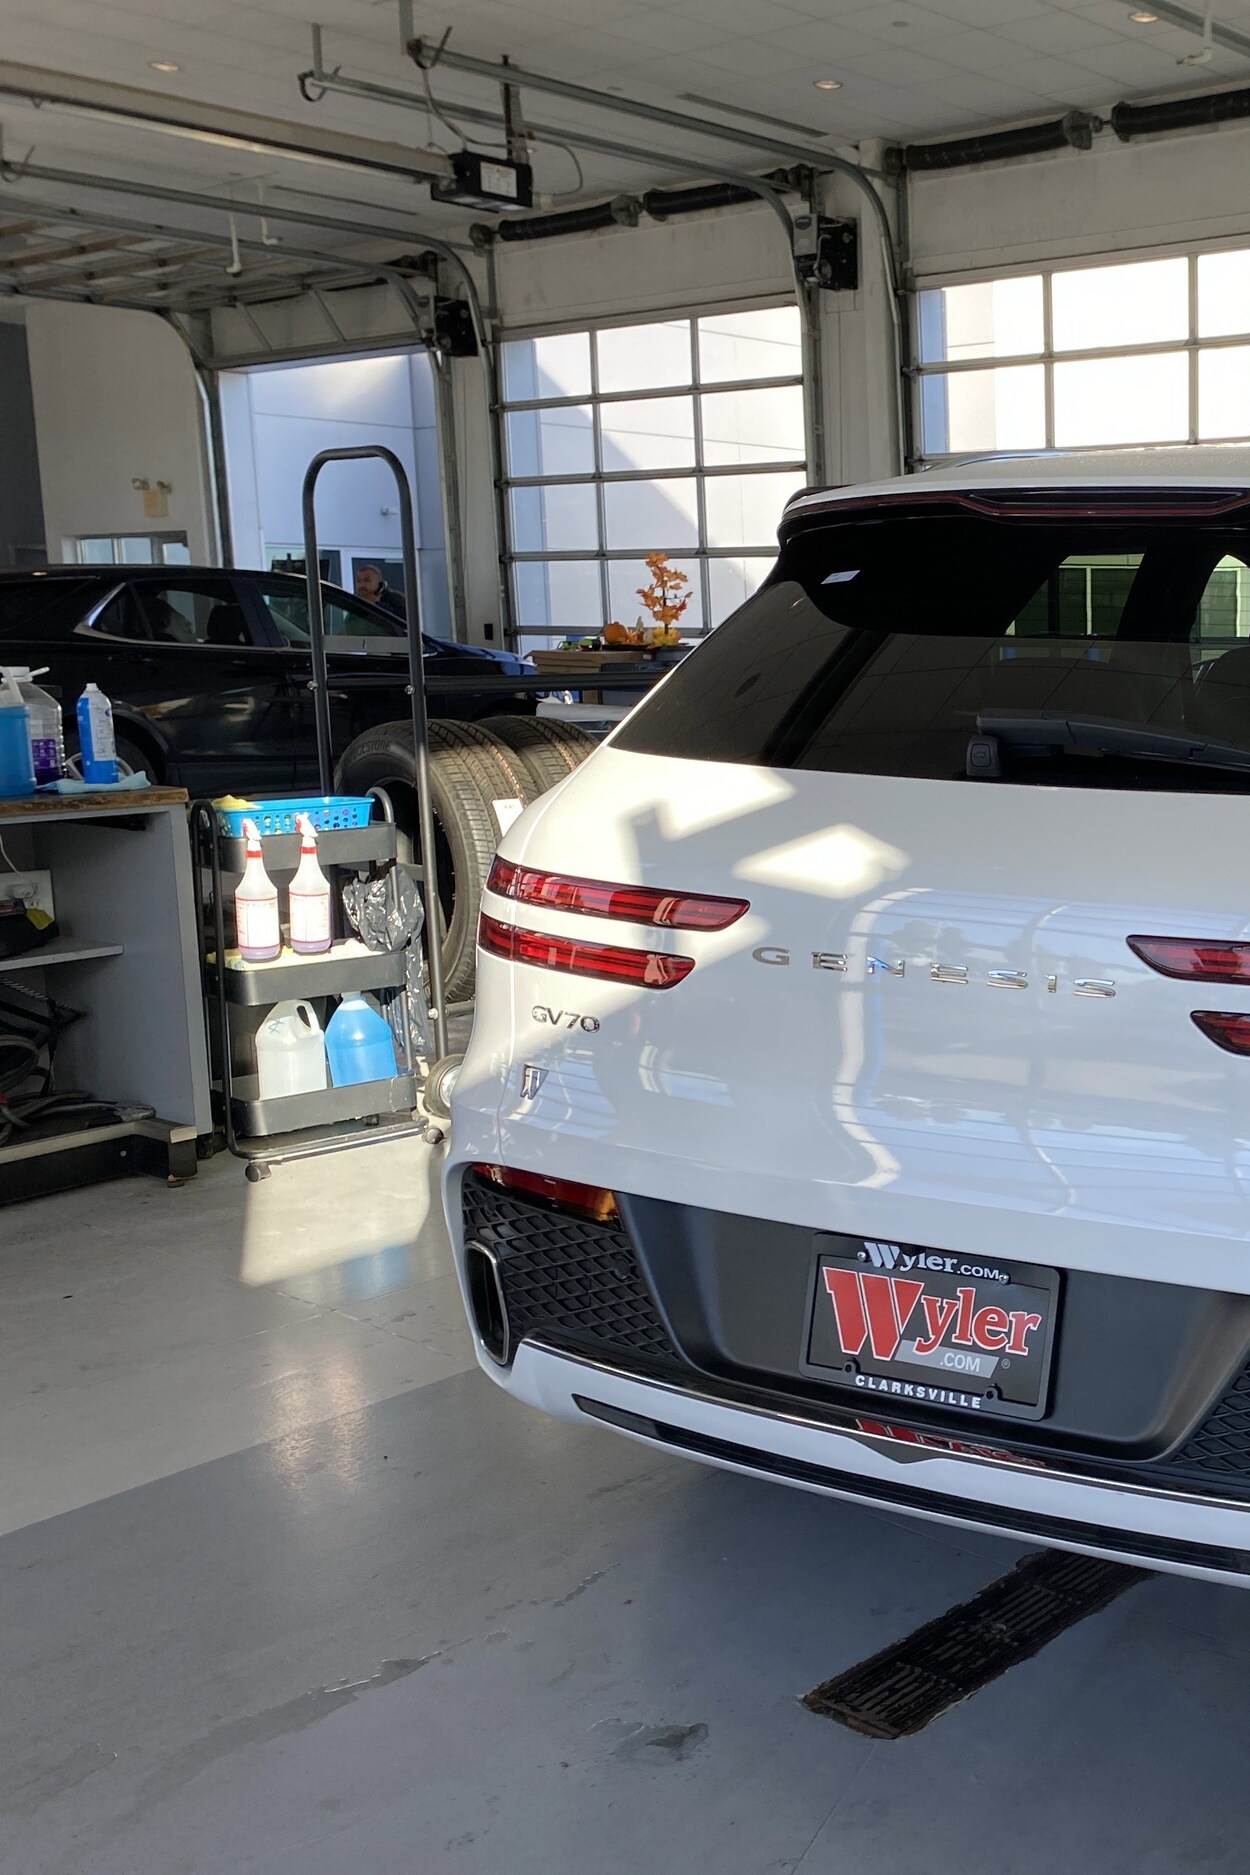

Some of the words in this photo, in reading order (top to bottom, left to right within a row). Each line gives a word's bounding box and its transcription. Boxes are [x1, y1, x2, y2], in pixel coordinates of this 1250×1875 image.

[752, 946, 1116, 998] GENESIS
[531, 1005, 600, 1033] GV70
[822, 1266, 1042, 1361] Wyler
[855, 1374, 982, 1409] CLARKSVILLE
